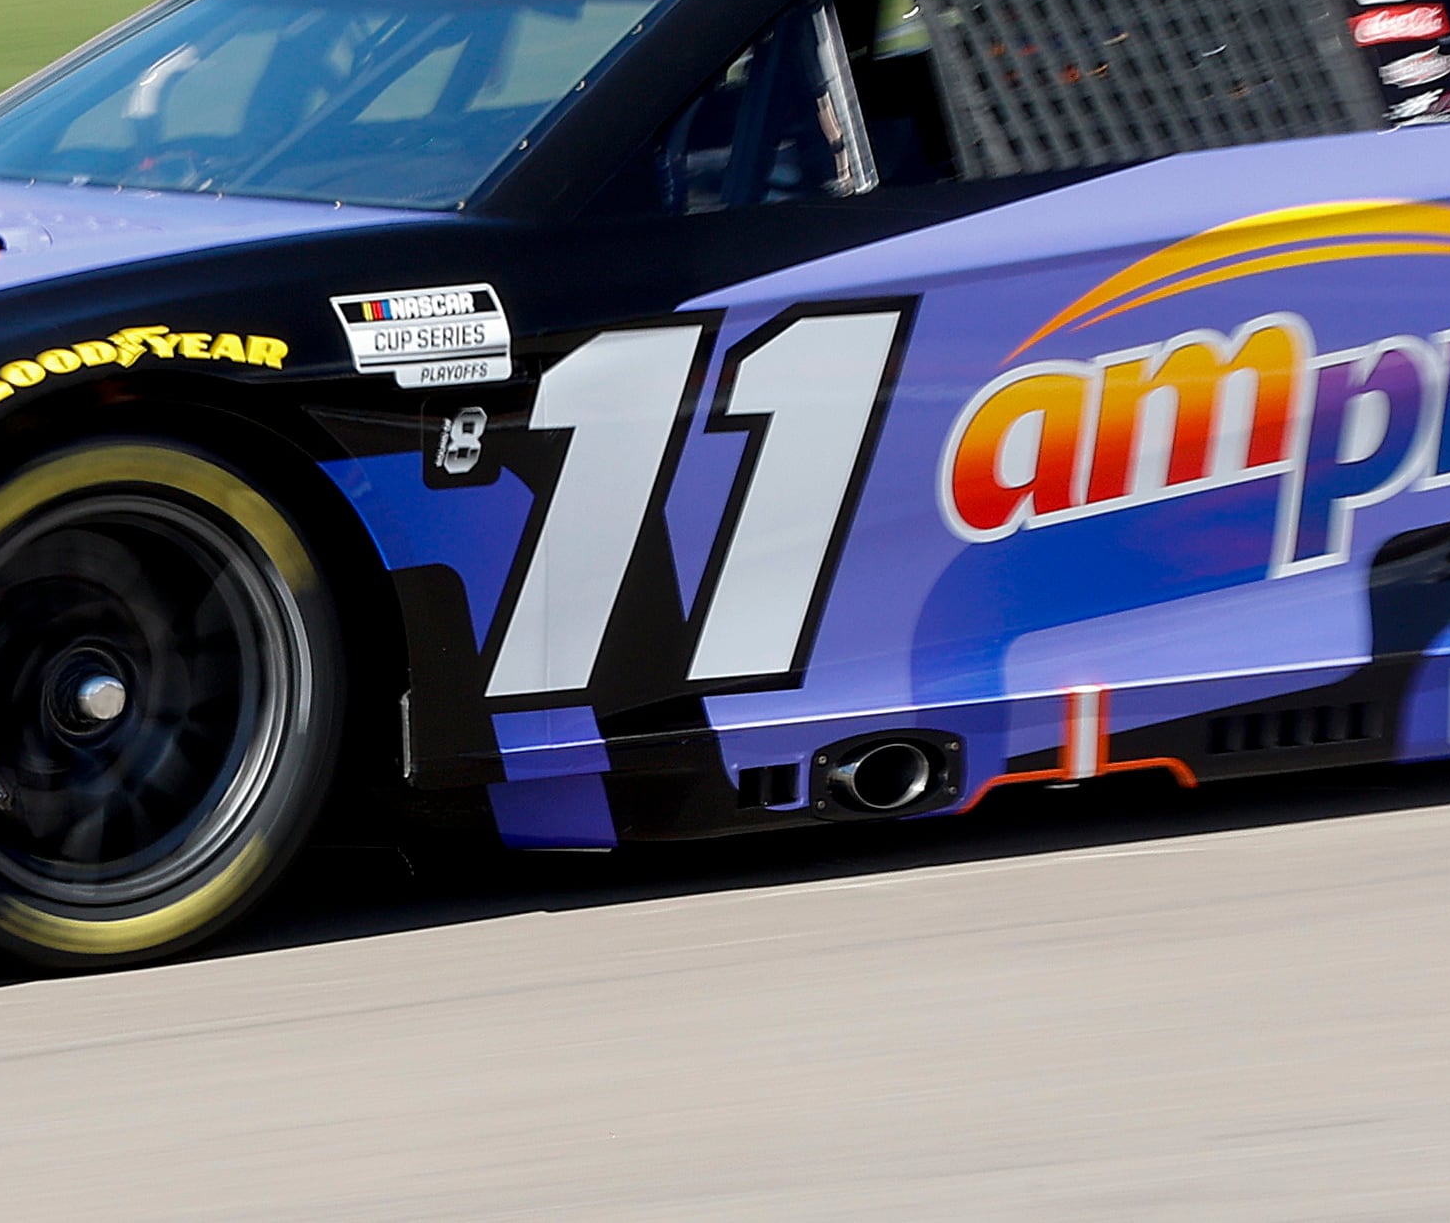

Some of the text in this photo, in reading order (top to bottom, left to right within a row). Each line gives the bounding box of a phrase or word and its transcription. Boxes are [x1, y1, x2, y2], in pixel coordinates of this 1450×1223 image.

[390, 292, 475, 320] NASCAR
[374, 323, 486, 353] CUP SERIES
[420, 362, 489, 384] PLAYOFFS
[443, 406, 488, 475] 8
[484, 308, 904, 699] 11
